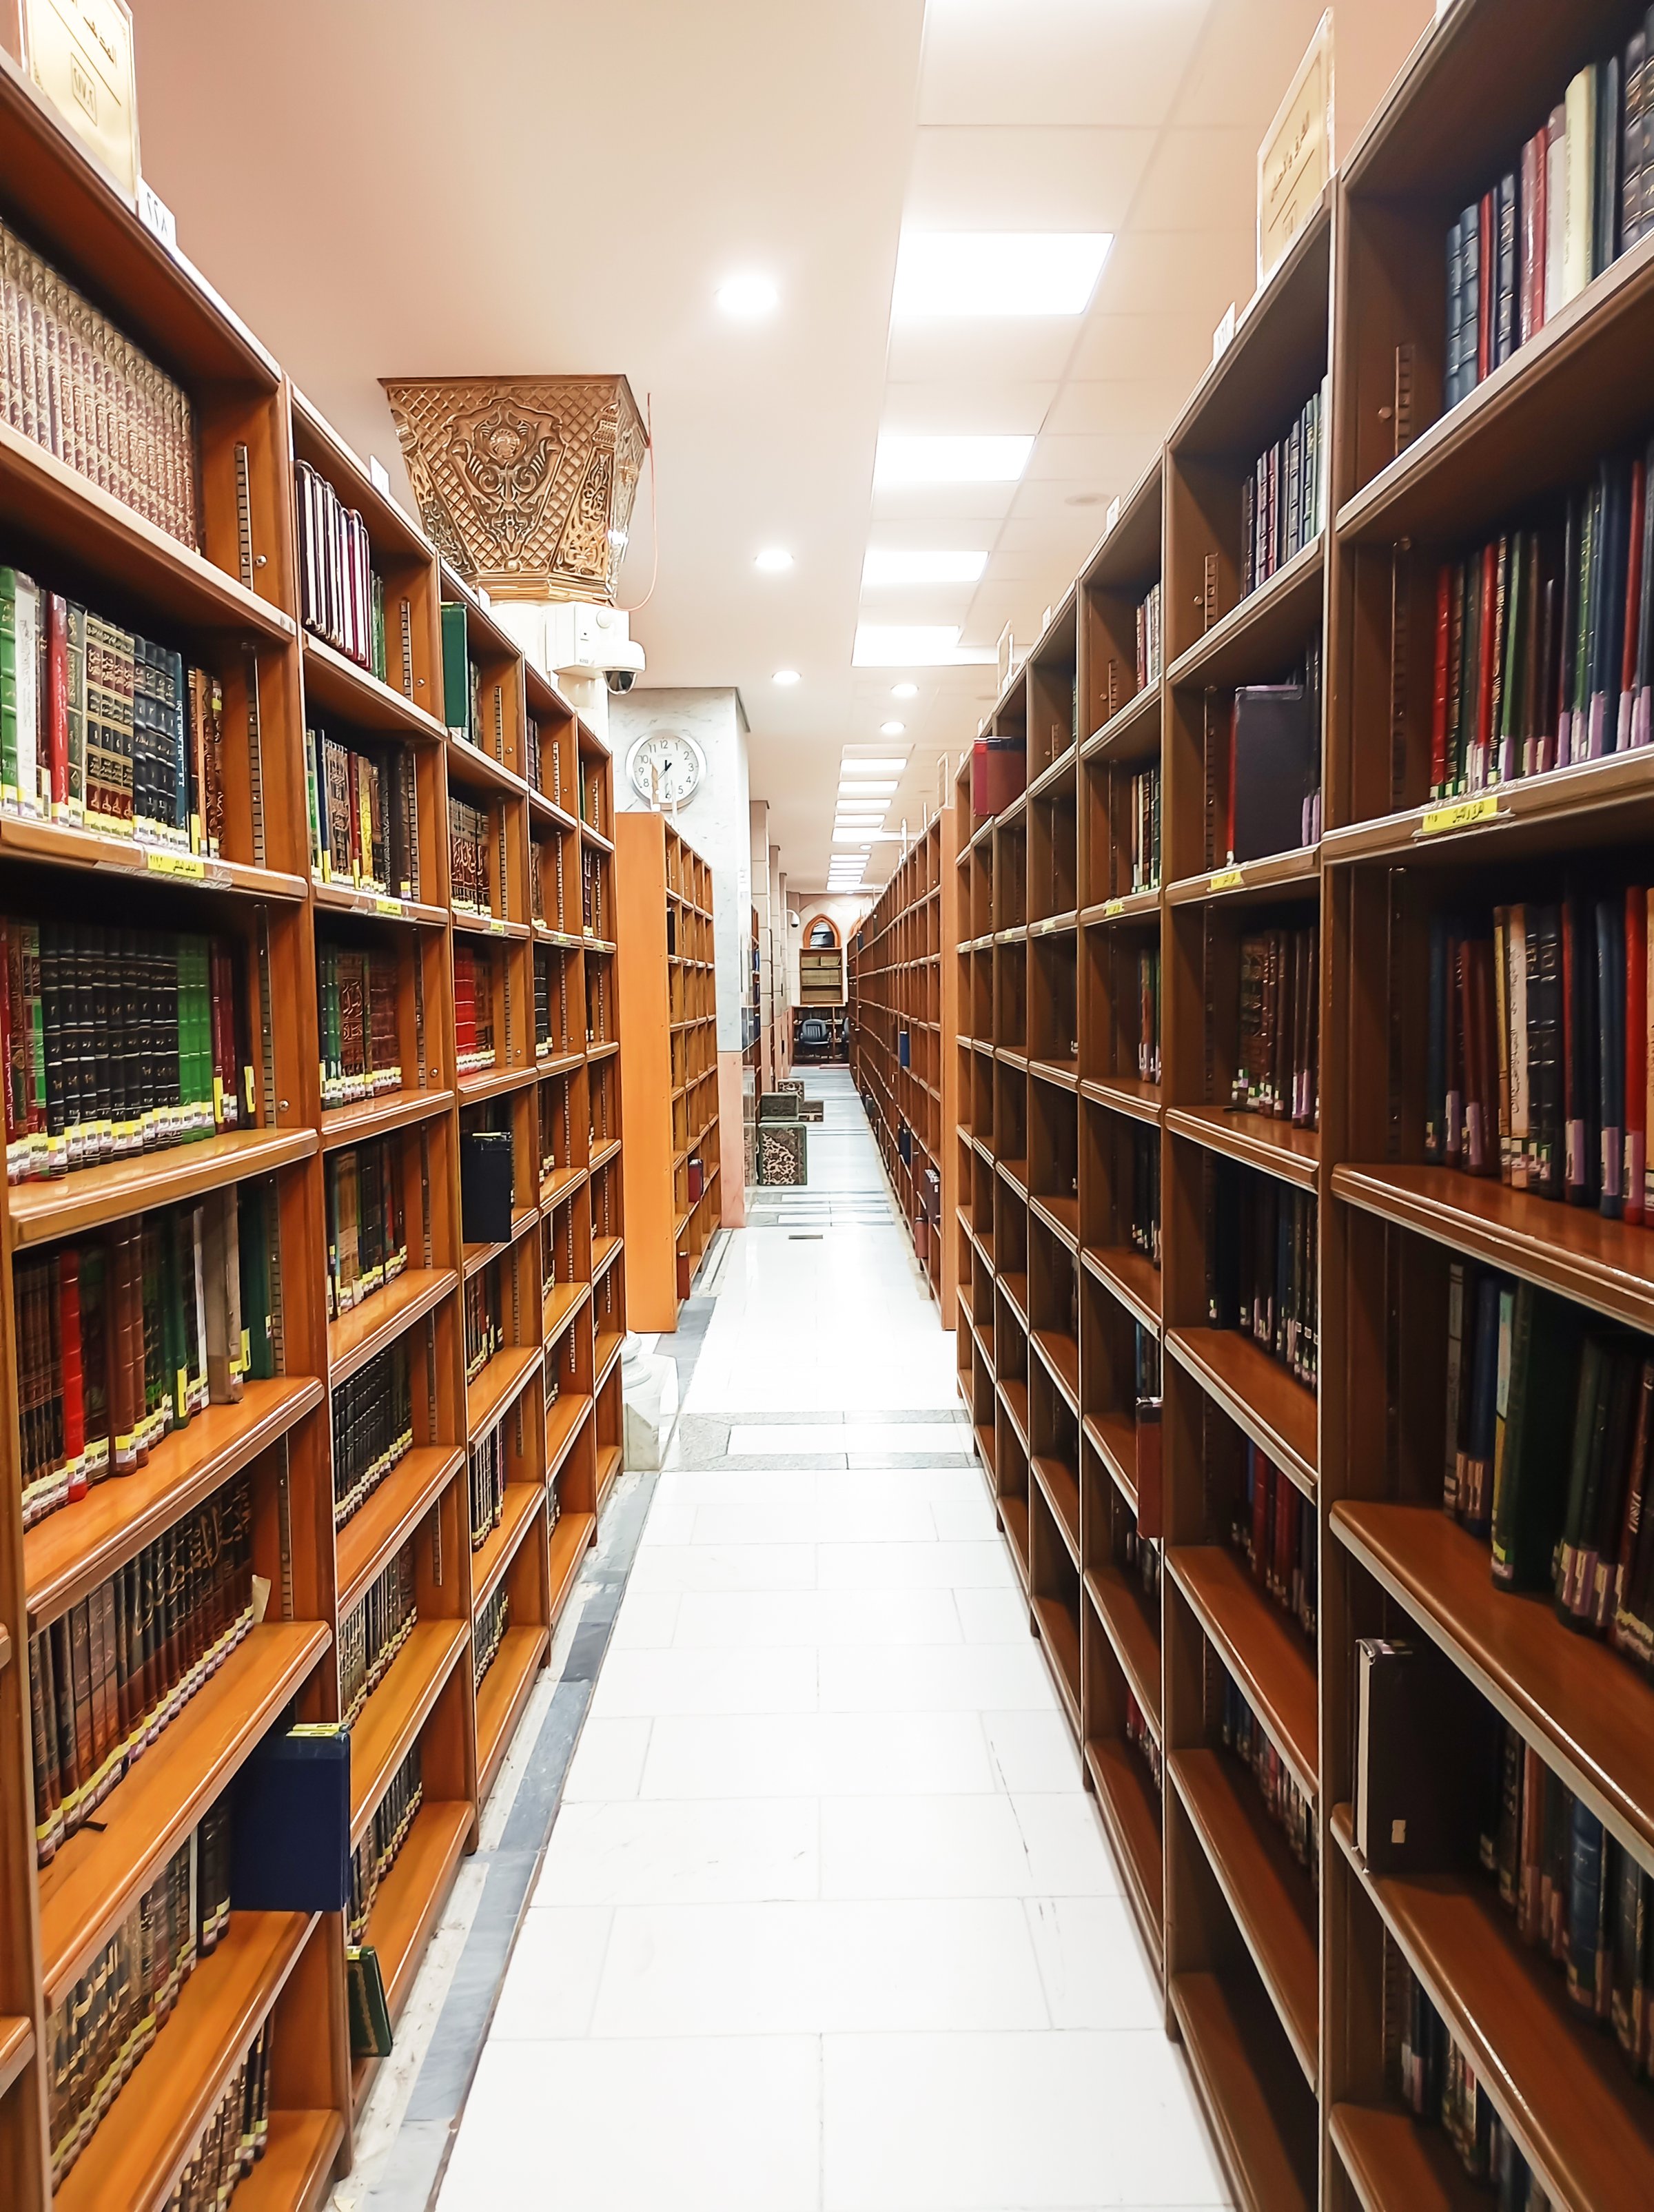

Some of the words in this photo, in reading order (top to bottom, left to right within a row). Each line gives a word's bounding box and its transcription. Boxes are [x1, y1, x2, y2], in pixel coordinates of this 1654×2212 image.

[648, 742, 656, 753] 11
[660, 739, 668, 749] 12
[675, 742, 679, 751] 1
[637, 755, 649, 764] 10
[683, 750, 690, 761] 2
[638, 766, 644, 776] 9
[688, 762, 694, 772] 3
[643, 778, 649, 788] 8
[686, 775, 691, 784] 4
[665, 790, 672, 799] 6
[677, 785, 684, 795] 5
